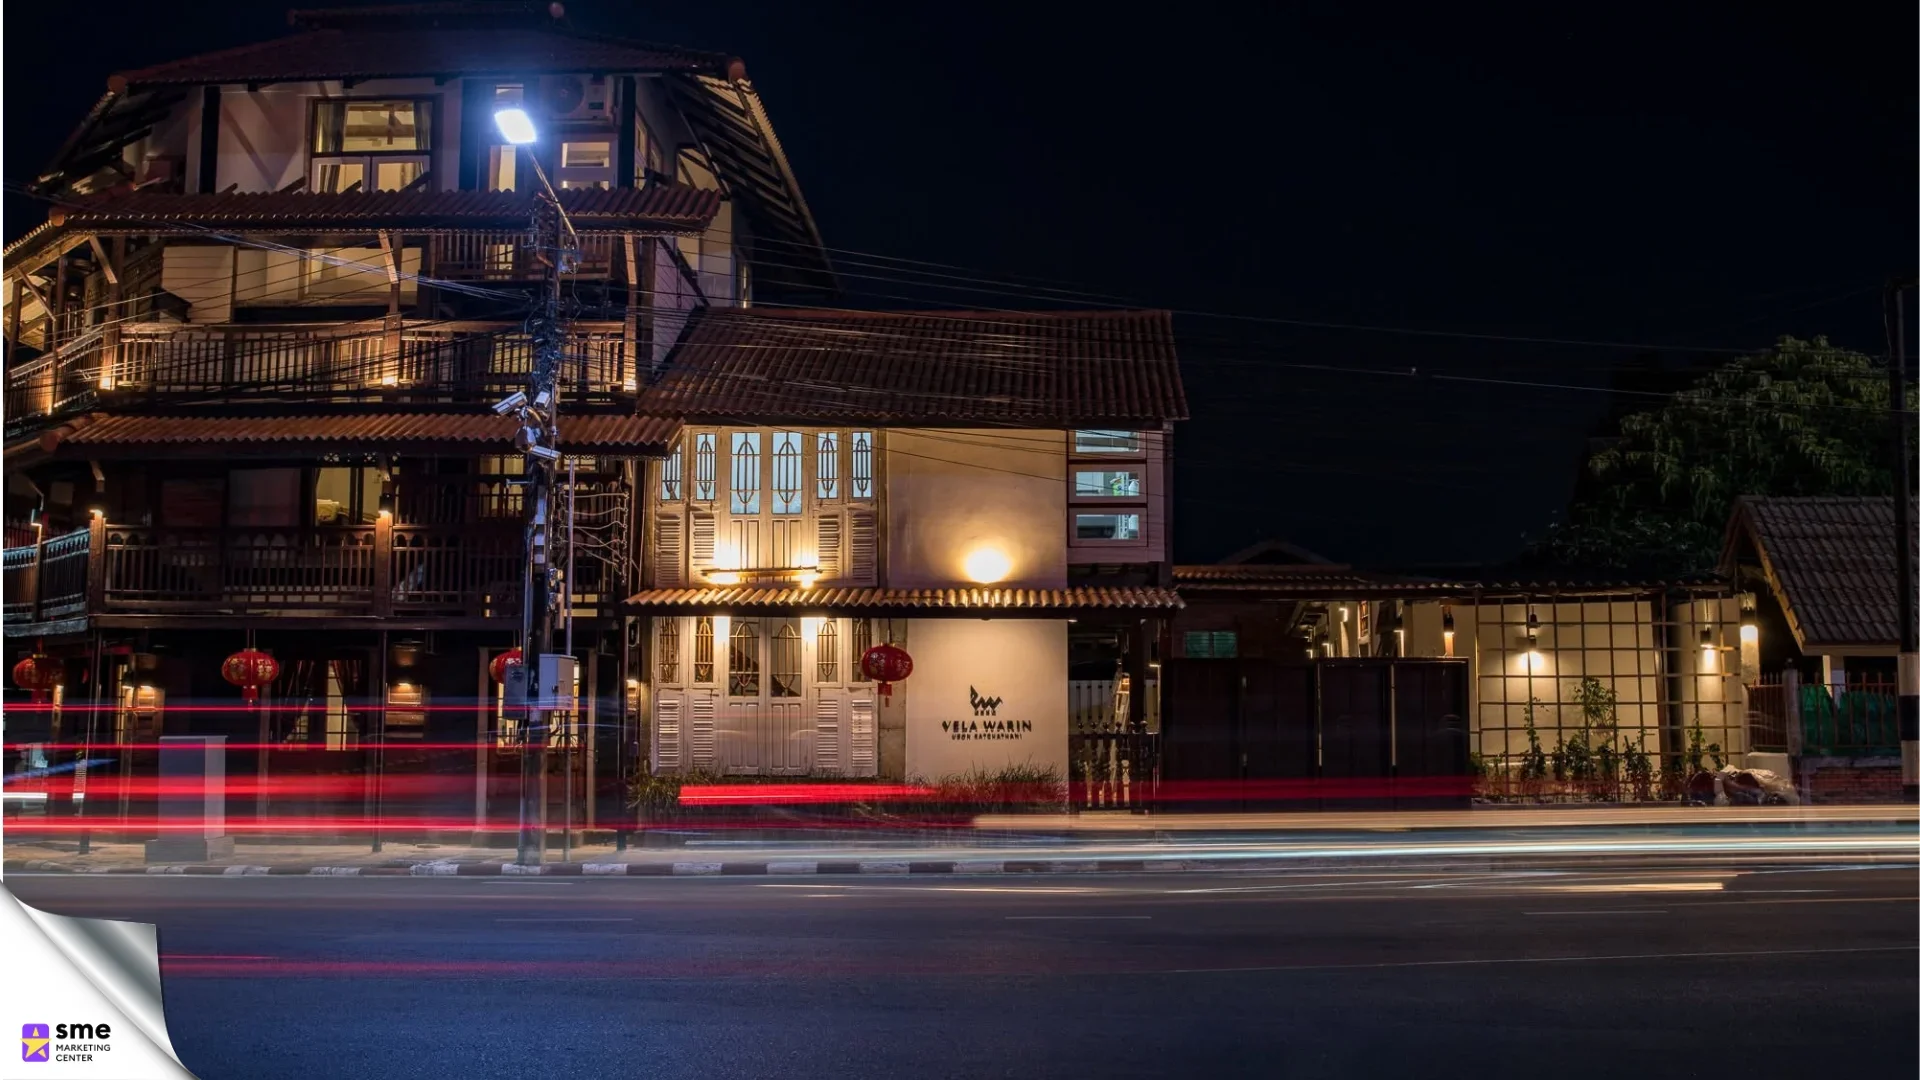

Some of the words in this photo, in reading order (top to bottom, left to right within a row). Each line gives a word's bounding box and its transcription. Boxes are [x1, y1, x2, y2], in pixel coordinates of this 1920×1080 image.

[942, 720, 978, 733] VELA
[983, 720, 1032, 733] WARIN
[951, 733, 971, 741] UBON
